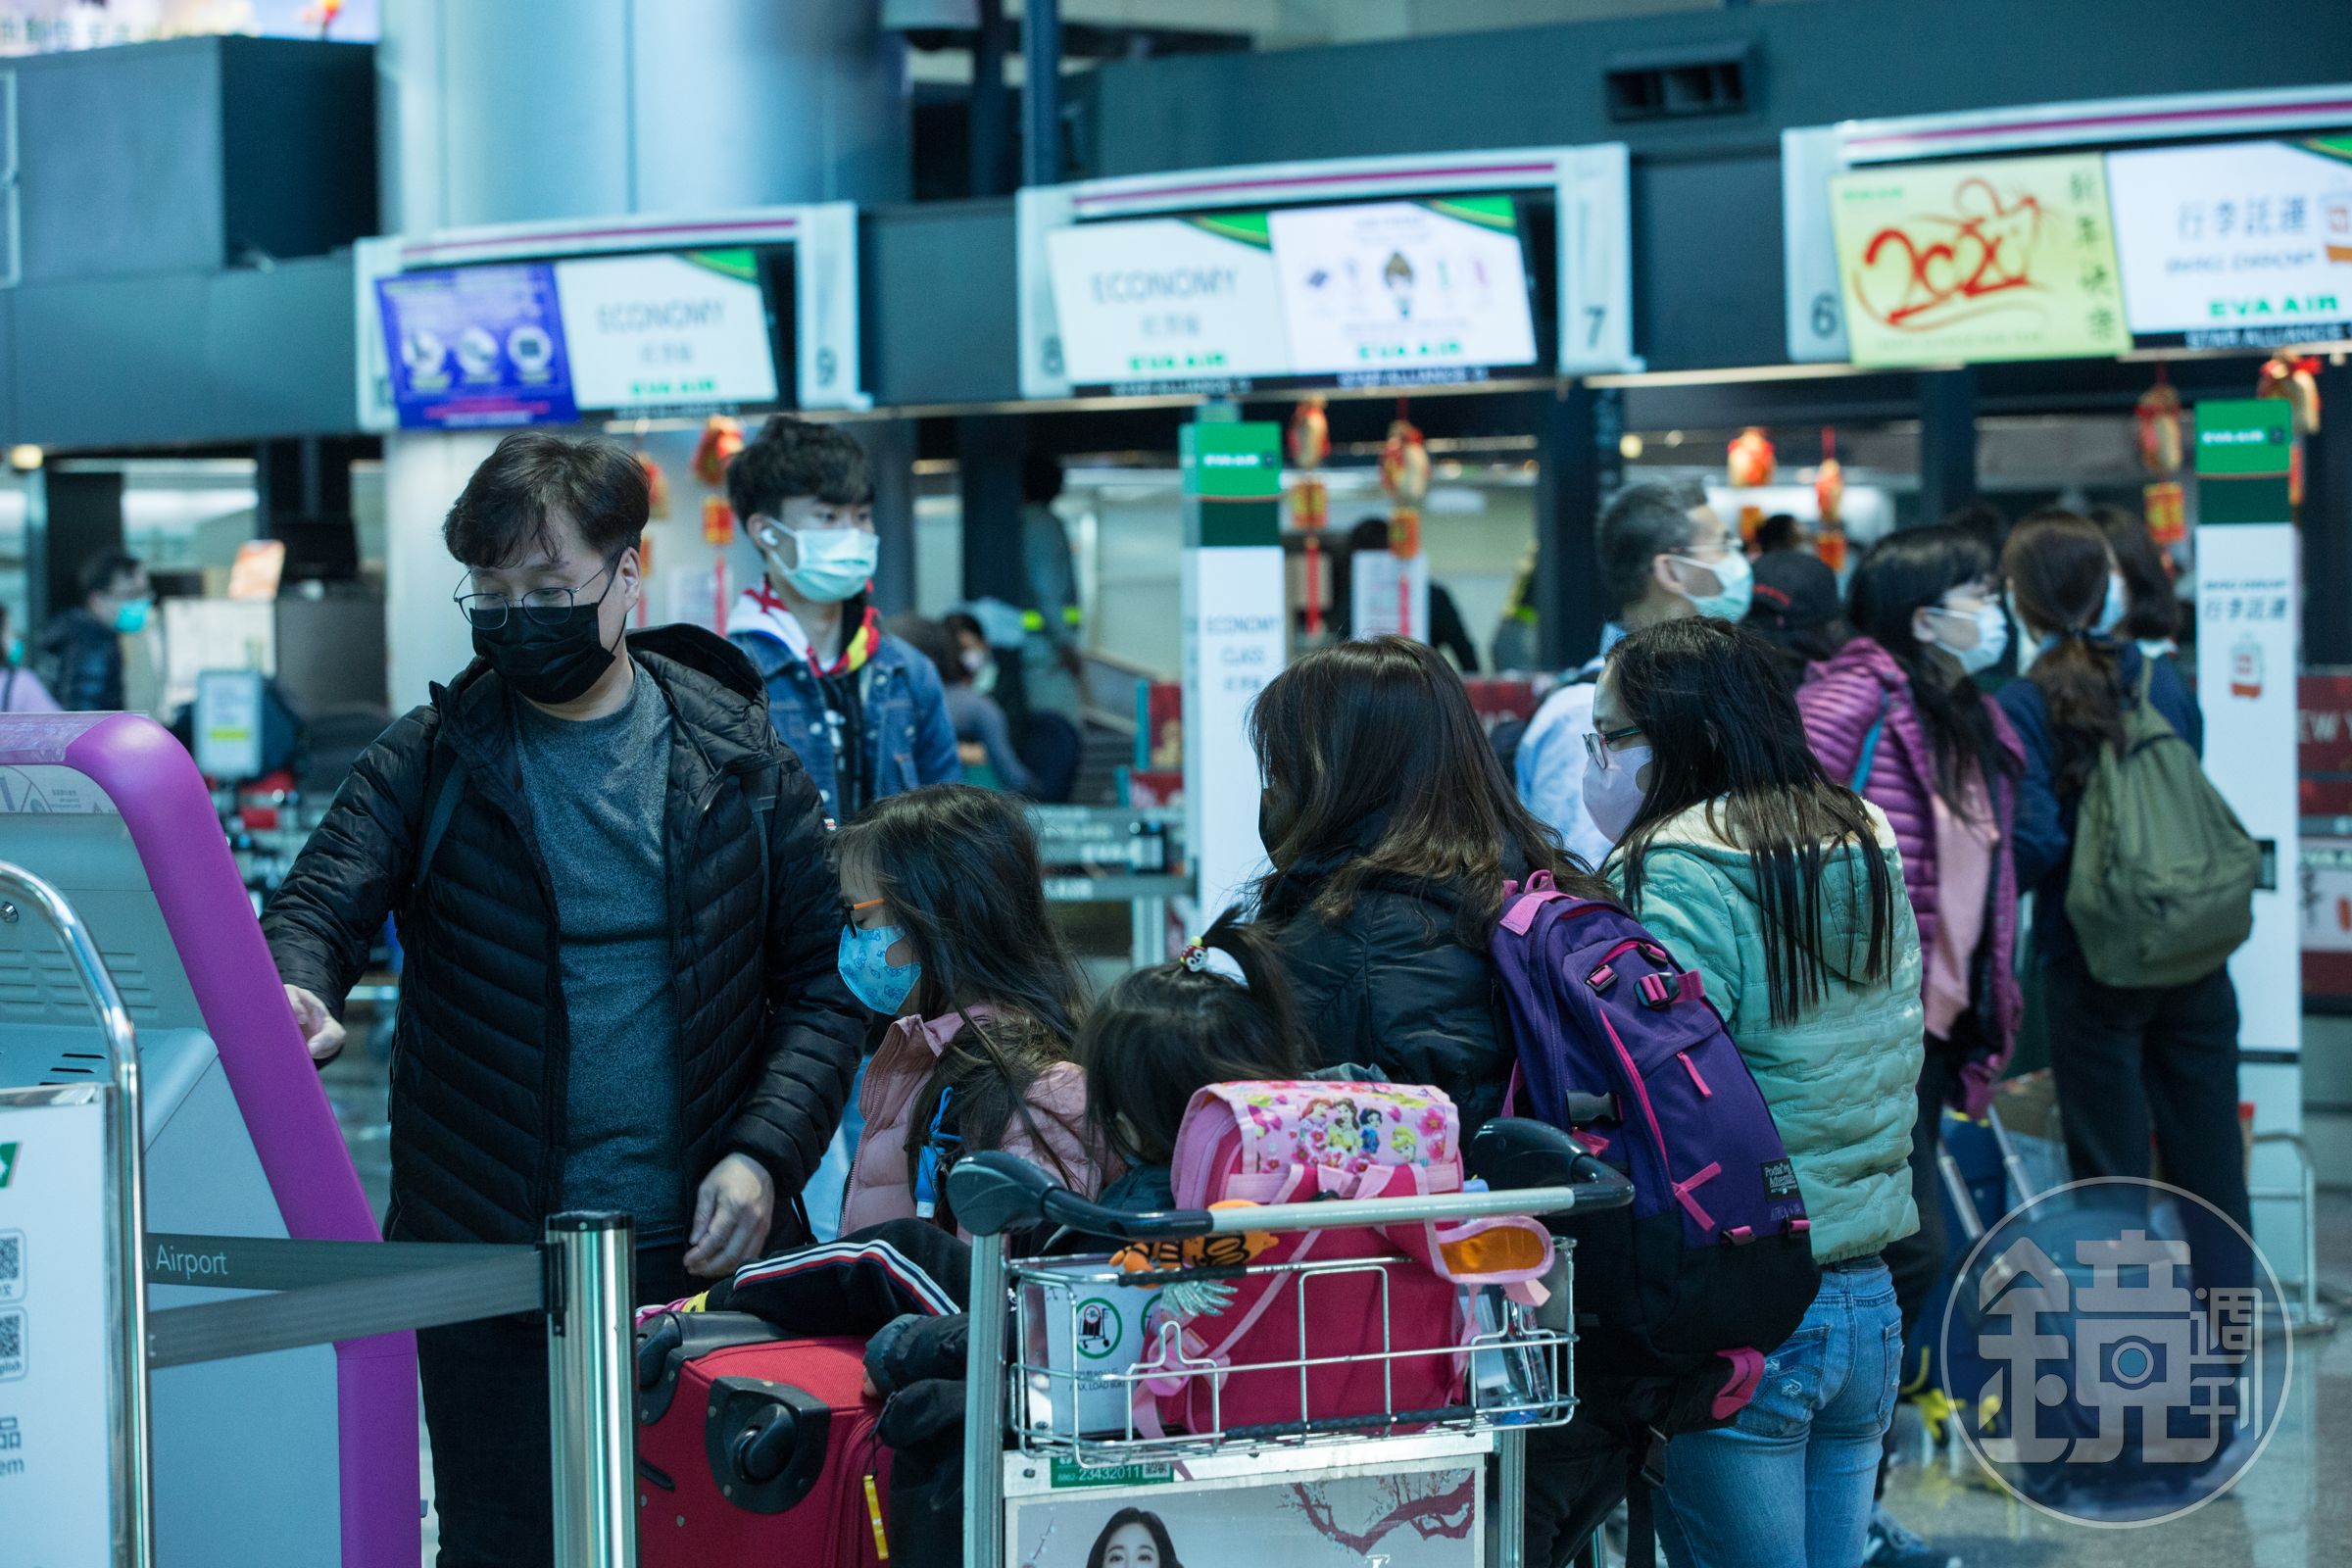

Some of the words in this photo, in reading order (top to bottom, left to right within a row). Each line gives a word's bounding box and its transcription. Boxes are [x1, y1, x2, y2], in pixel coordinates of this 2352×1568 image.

[1090, 267, 1238, 304] ECONOMY
[596, 299, 725, 334] ECONOMY
[1810, 293, 1837, 340] 6
[2209, 298, 2273, 318] EVA
[2282, 295, 2339, 315] AIR
[1584, 305, 1606, 350] 7
[815, 348, 838, 389] 9
[1205, 613, 1280, 635] ECONOMY
[1221, 645, 1265, 667] CLASS
[155, 1243, 228, 1281] Airport
